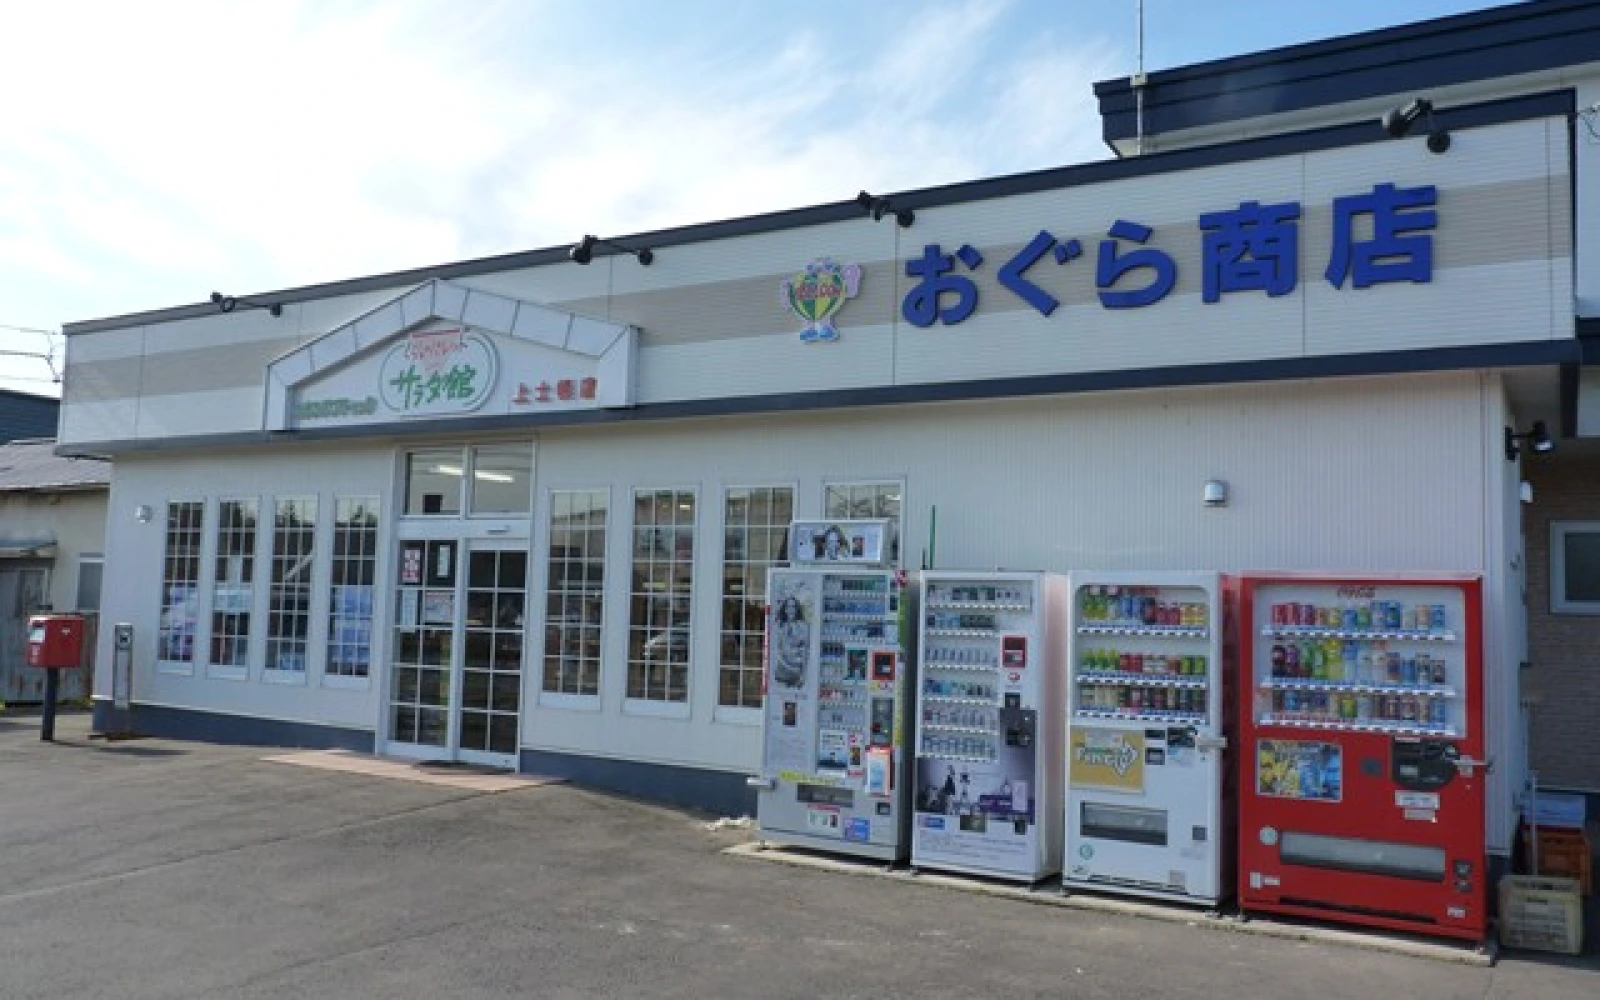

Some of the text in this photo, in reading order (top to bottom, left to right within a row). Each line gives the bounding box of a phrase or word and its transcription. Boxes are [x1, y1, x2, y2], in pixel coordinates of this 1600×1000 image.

[902, 181, 1439, 327] おぐら商店
[512, 377, 598, 405] 上士
